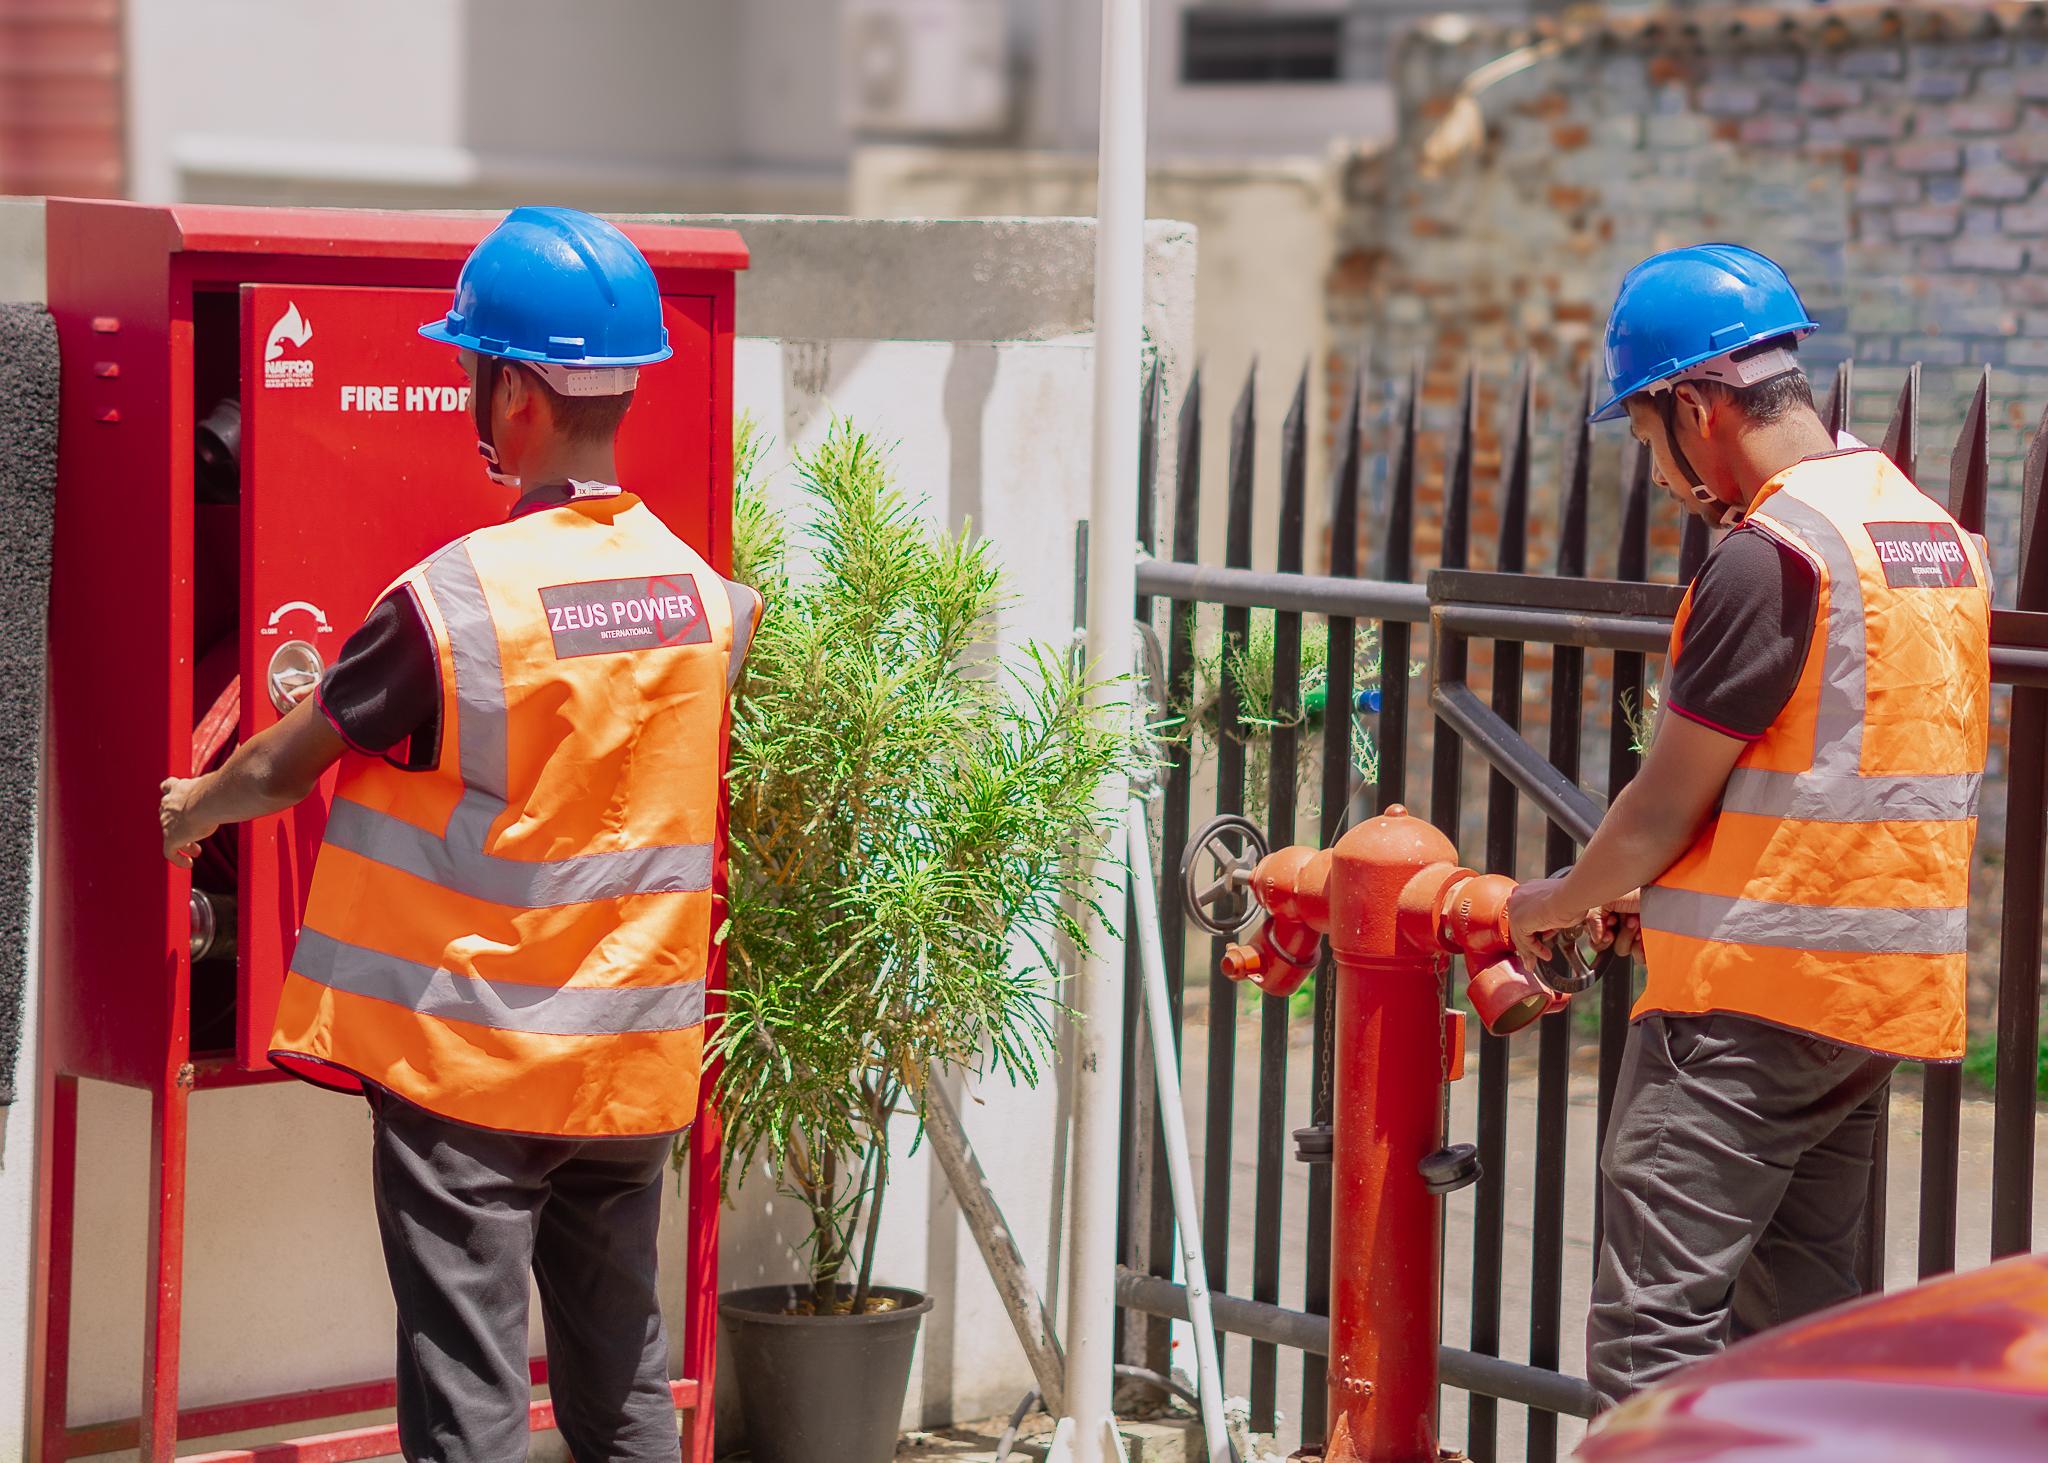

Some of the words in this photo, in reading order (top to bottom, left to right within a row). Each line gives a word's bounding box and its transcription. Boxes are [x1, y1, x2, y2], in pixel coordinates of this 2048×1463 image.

[265, 360, 314, 373] NAFFCO
[340, 385, 399, 412] FIRE
[1875, 541, 1915, 562] ZEUS
[1911, 541, 1965, 562] POWER
[1911, 566, 1943, 575] INTERNATIONAL
[548, 603, 608, 632] ZEUS
[611, 595, 696, 625] POWER
[600, 626, 653, 639] INTERNATIONAL
